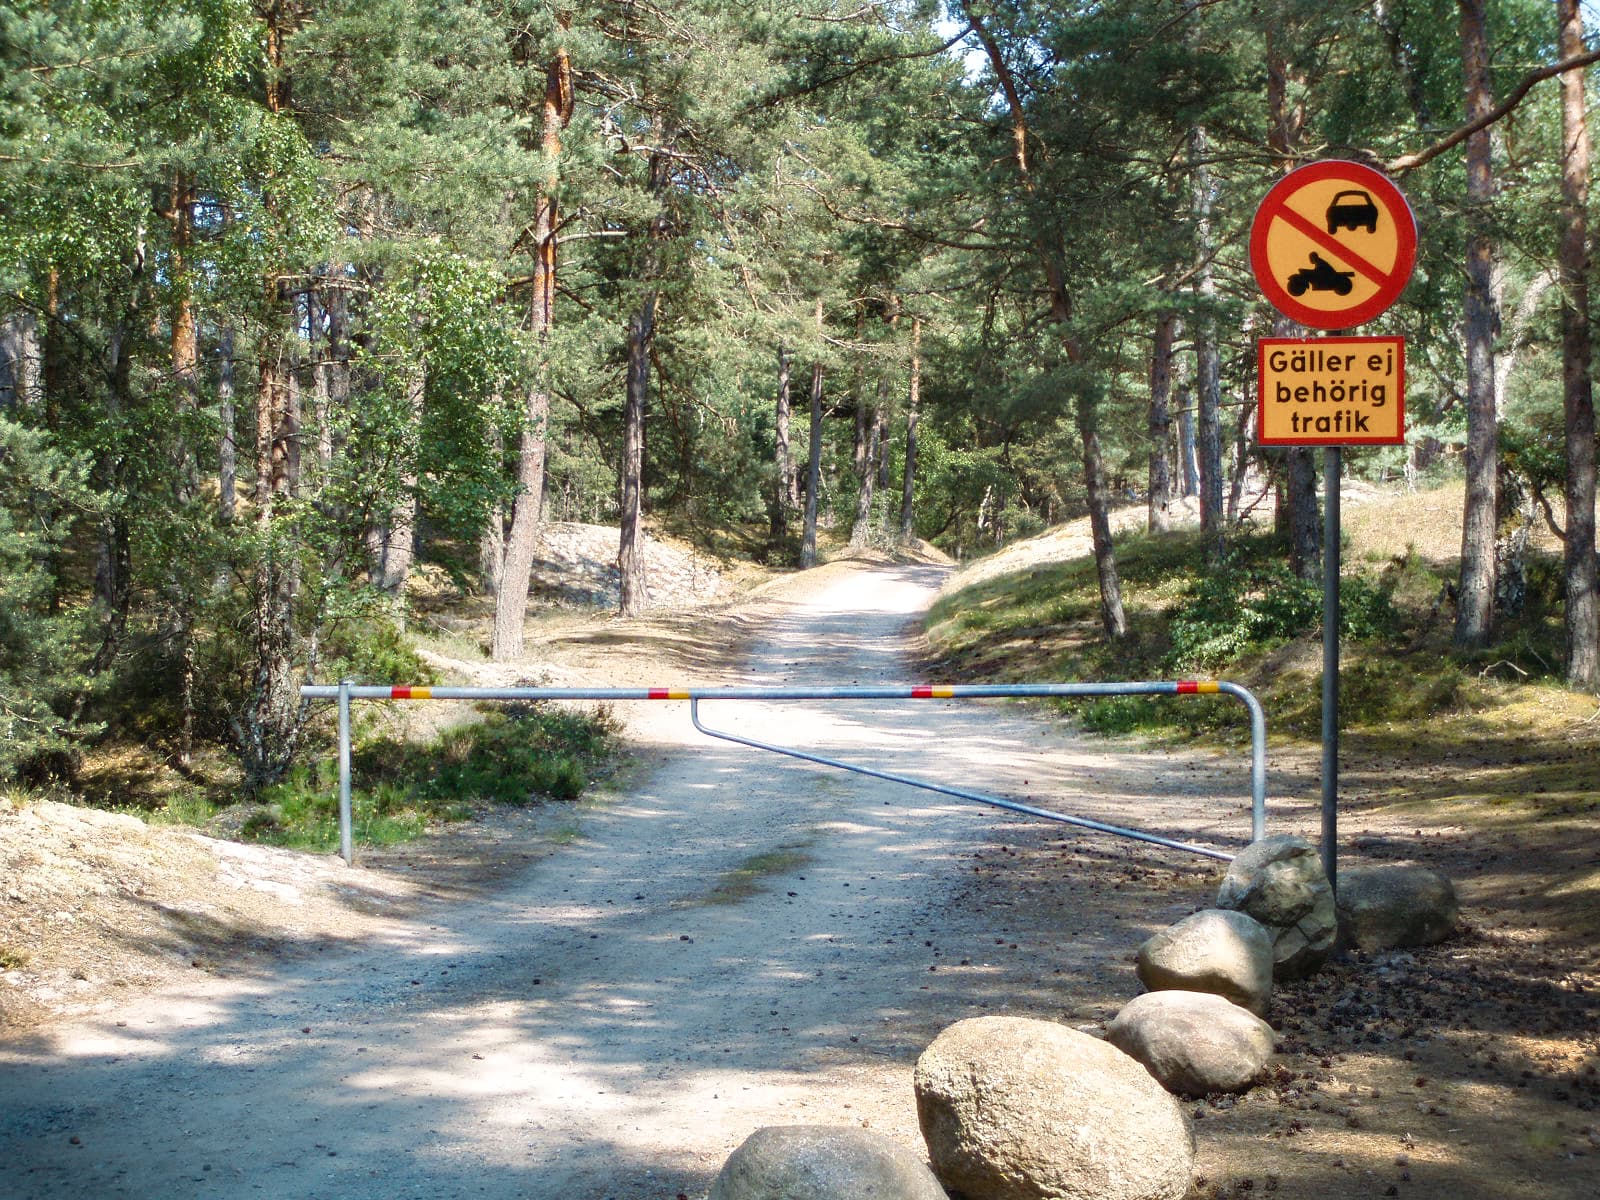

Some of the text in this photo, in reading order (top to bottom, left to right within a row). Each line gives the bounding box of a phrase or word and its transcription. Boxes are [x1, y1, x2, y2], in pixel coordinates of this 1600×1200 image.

[1269, 348, 1393, 377] Gäller ej
[1276, 379, 1386, 407] behörig
[1291, 410, 1370, 433] trafik
